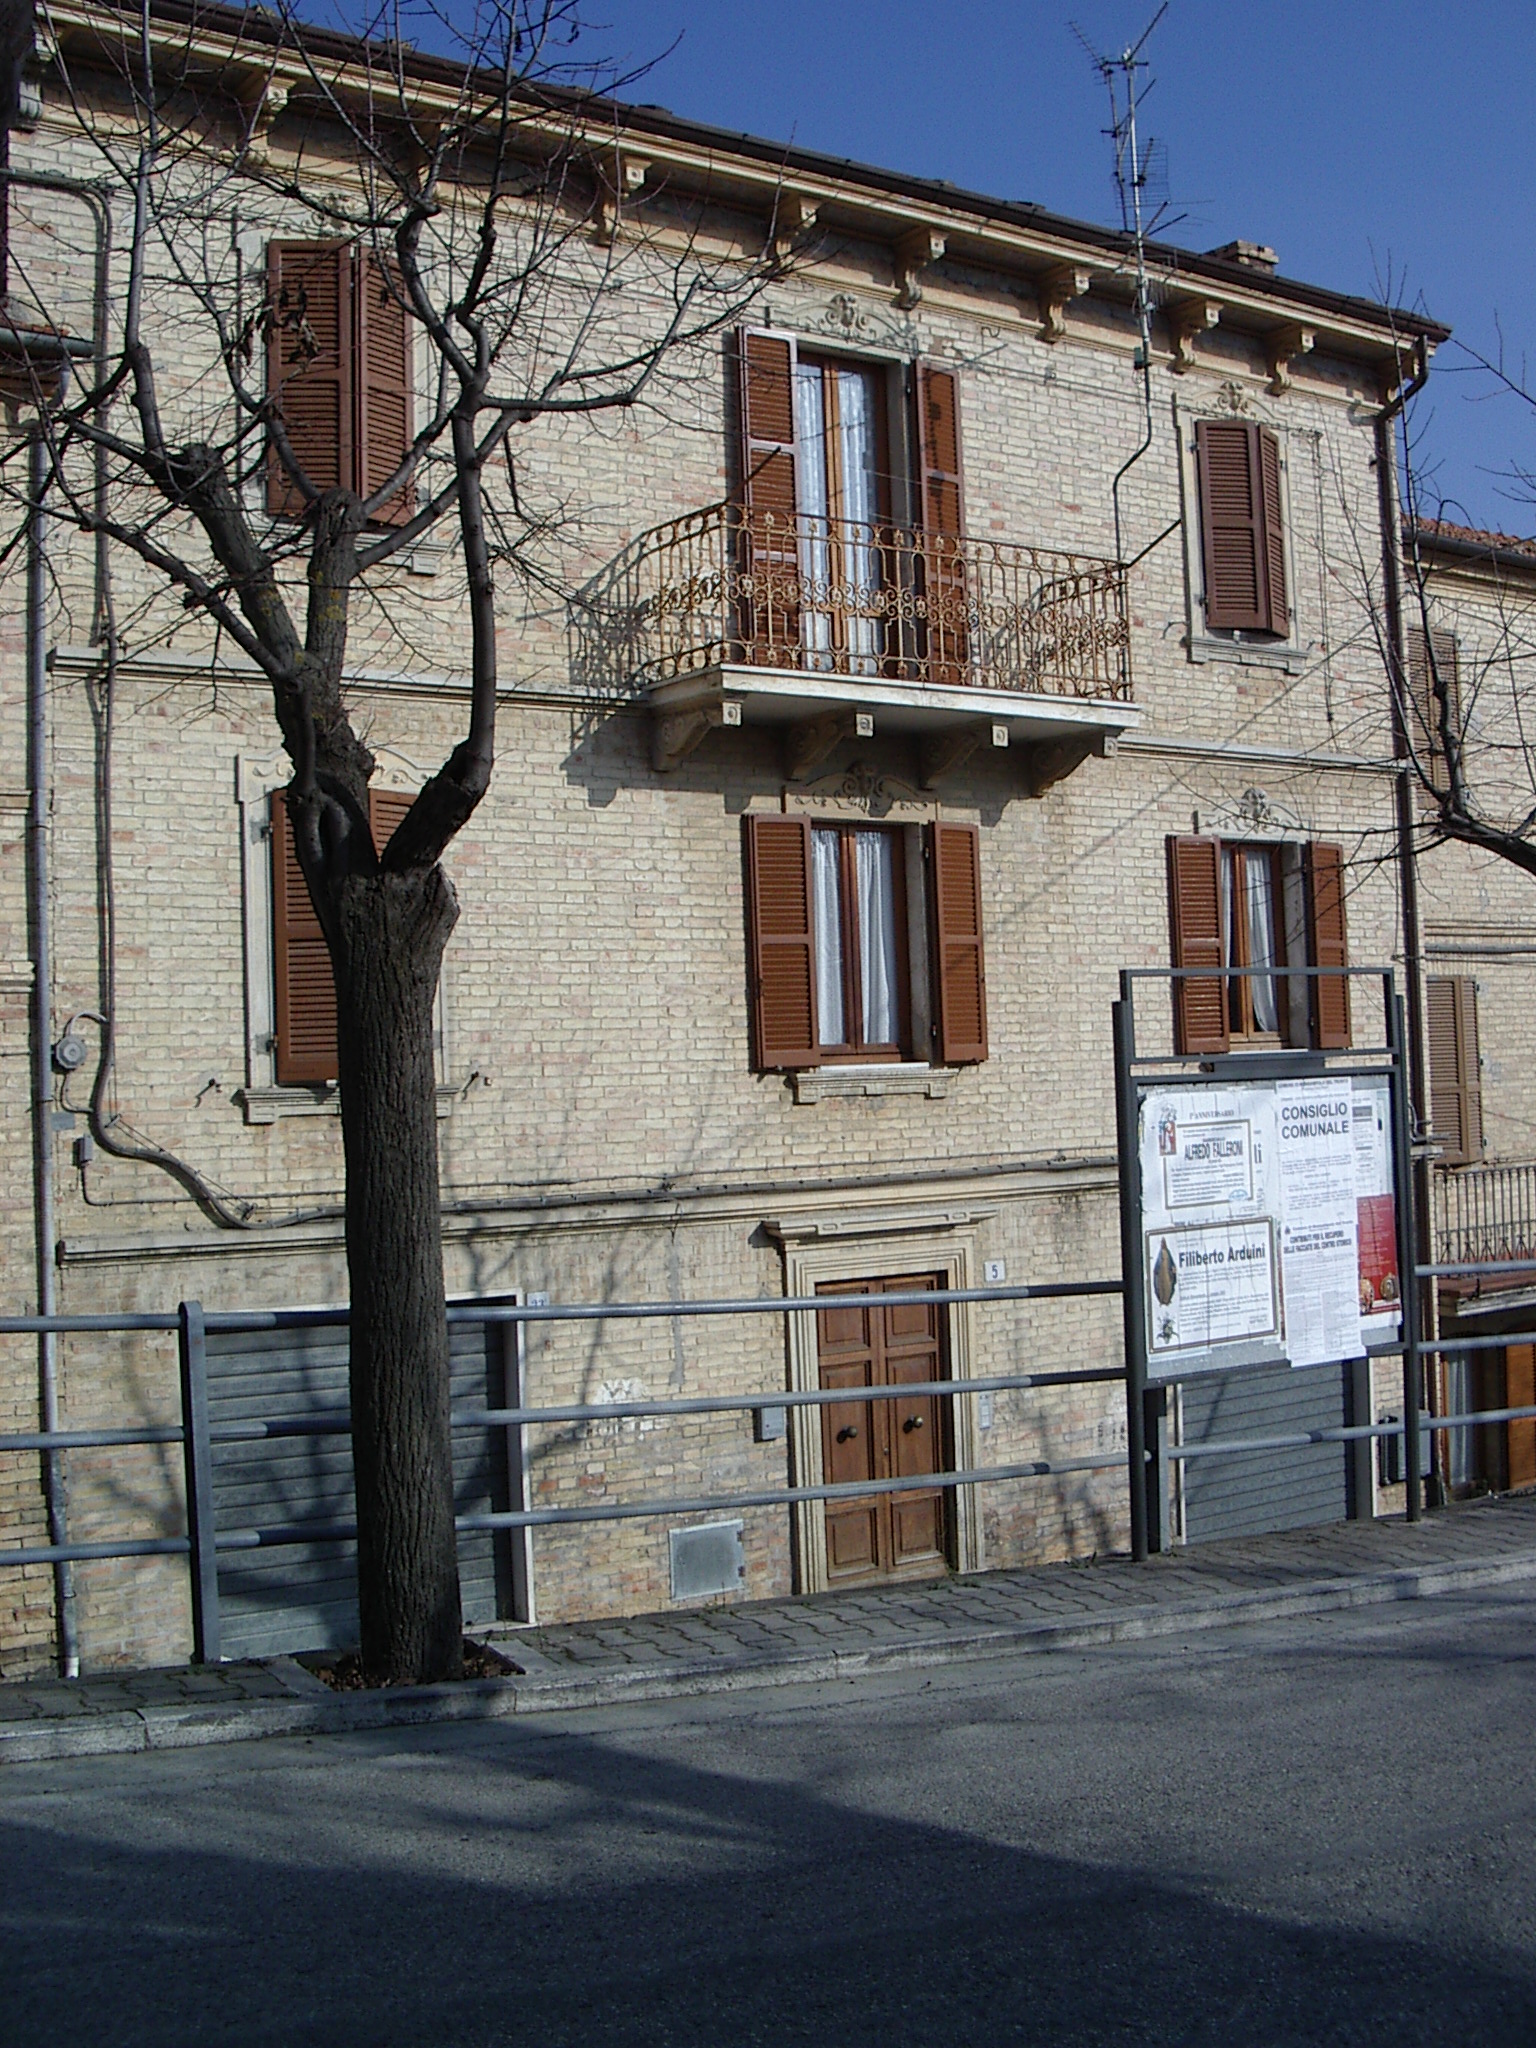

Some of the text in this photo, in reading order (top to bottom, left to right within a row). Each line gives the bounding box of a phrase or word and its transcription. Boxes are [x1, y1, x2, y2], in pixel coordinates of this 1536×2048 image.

[1281, 1102, 1348, 1121] CONSIGLIO
[1281, 1120, 1350, 1139] COMUNALE
[1178, 1242, 1266, 1268] Filiberto Arduini
[991, 1264, 999, 1279] 5
